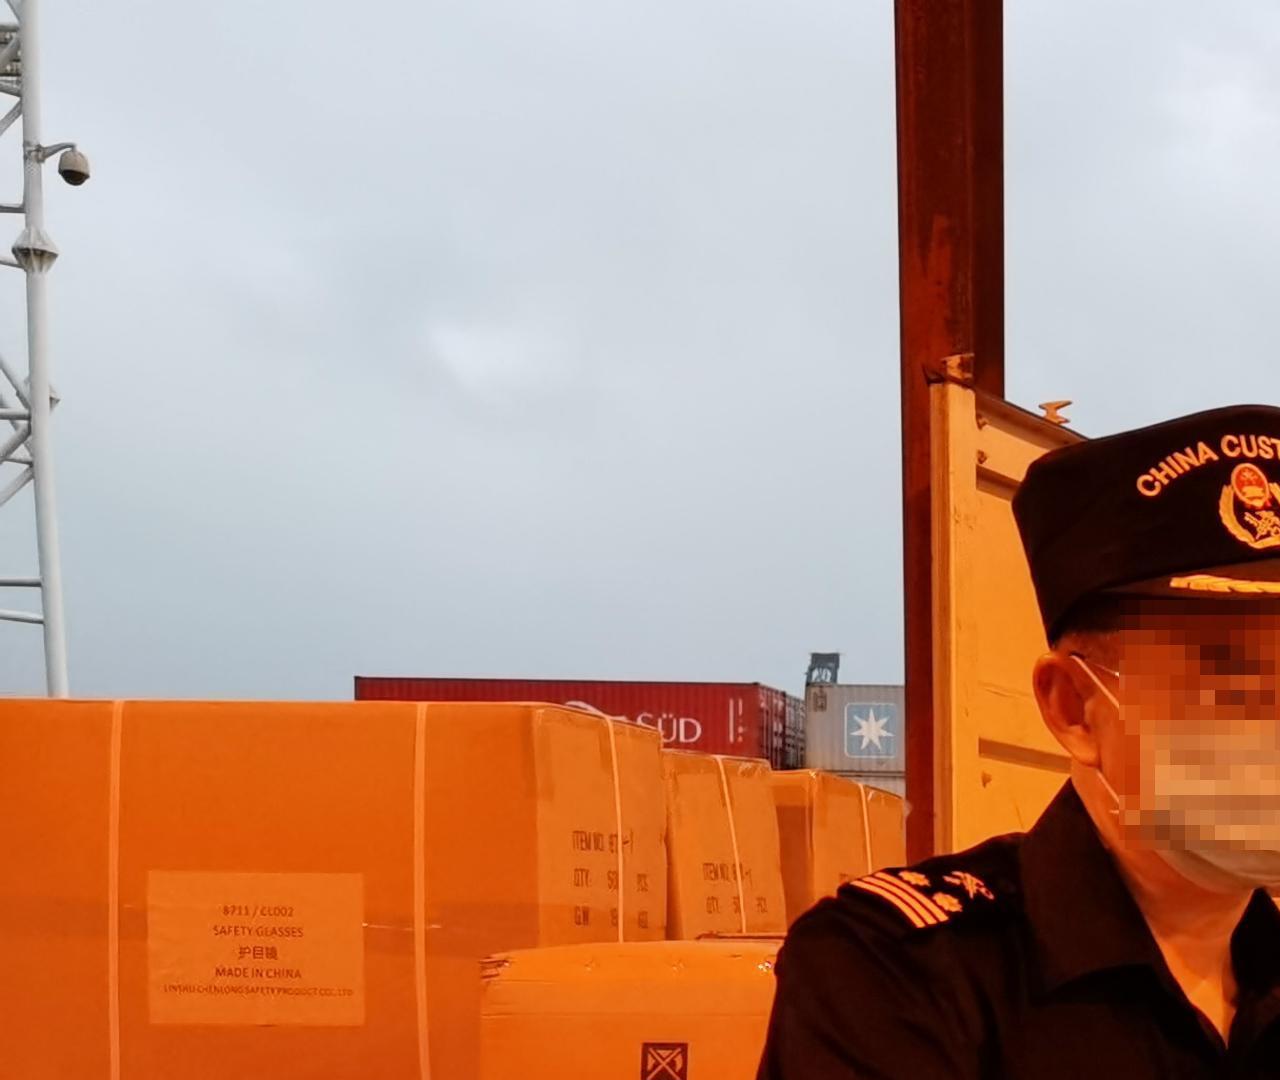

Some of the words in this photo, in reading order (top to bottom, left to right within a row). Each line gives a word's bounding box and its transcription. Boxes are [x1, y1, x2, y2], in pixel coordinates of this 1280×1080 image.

[1136, 441, 1219, 498] CHINA
[222, 905, 249, 917] 8711
[213, 924, 252, 937] SAFETY
[255, 925, 304, 938] GLASSES
[215, 967, 249, 978] MADE
[251, 968, 263, 979] IN
[265, 968, 302, 979] CHINA
